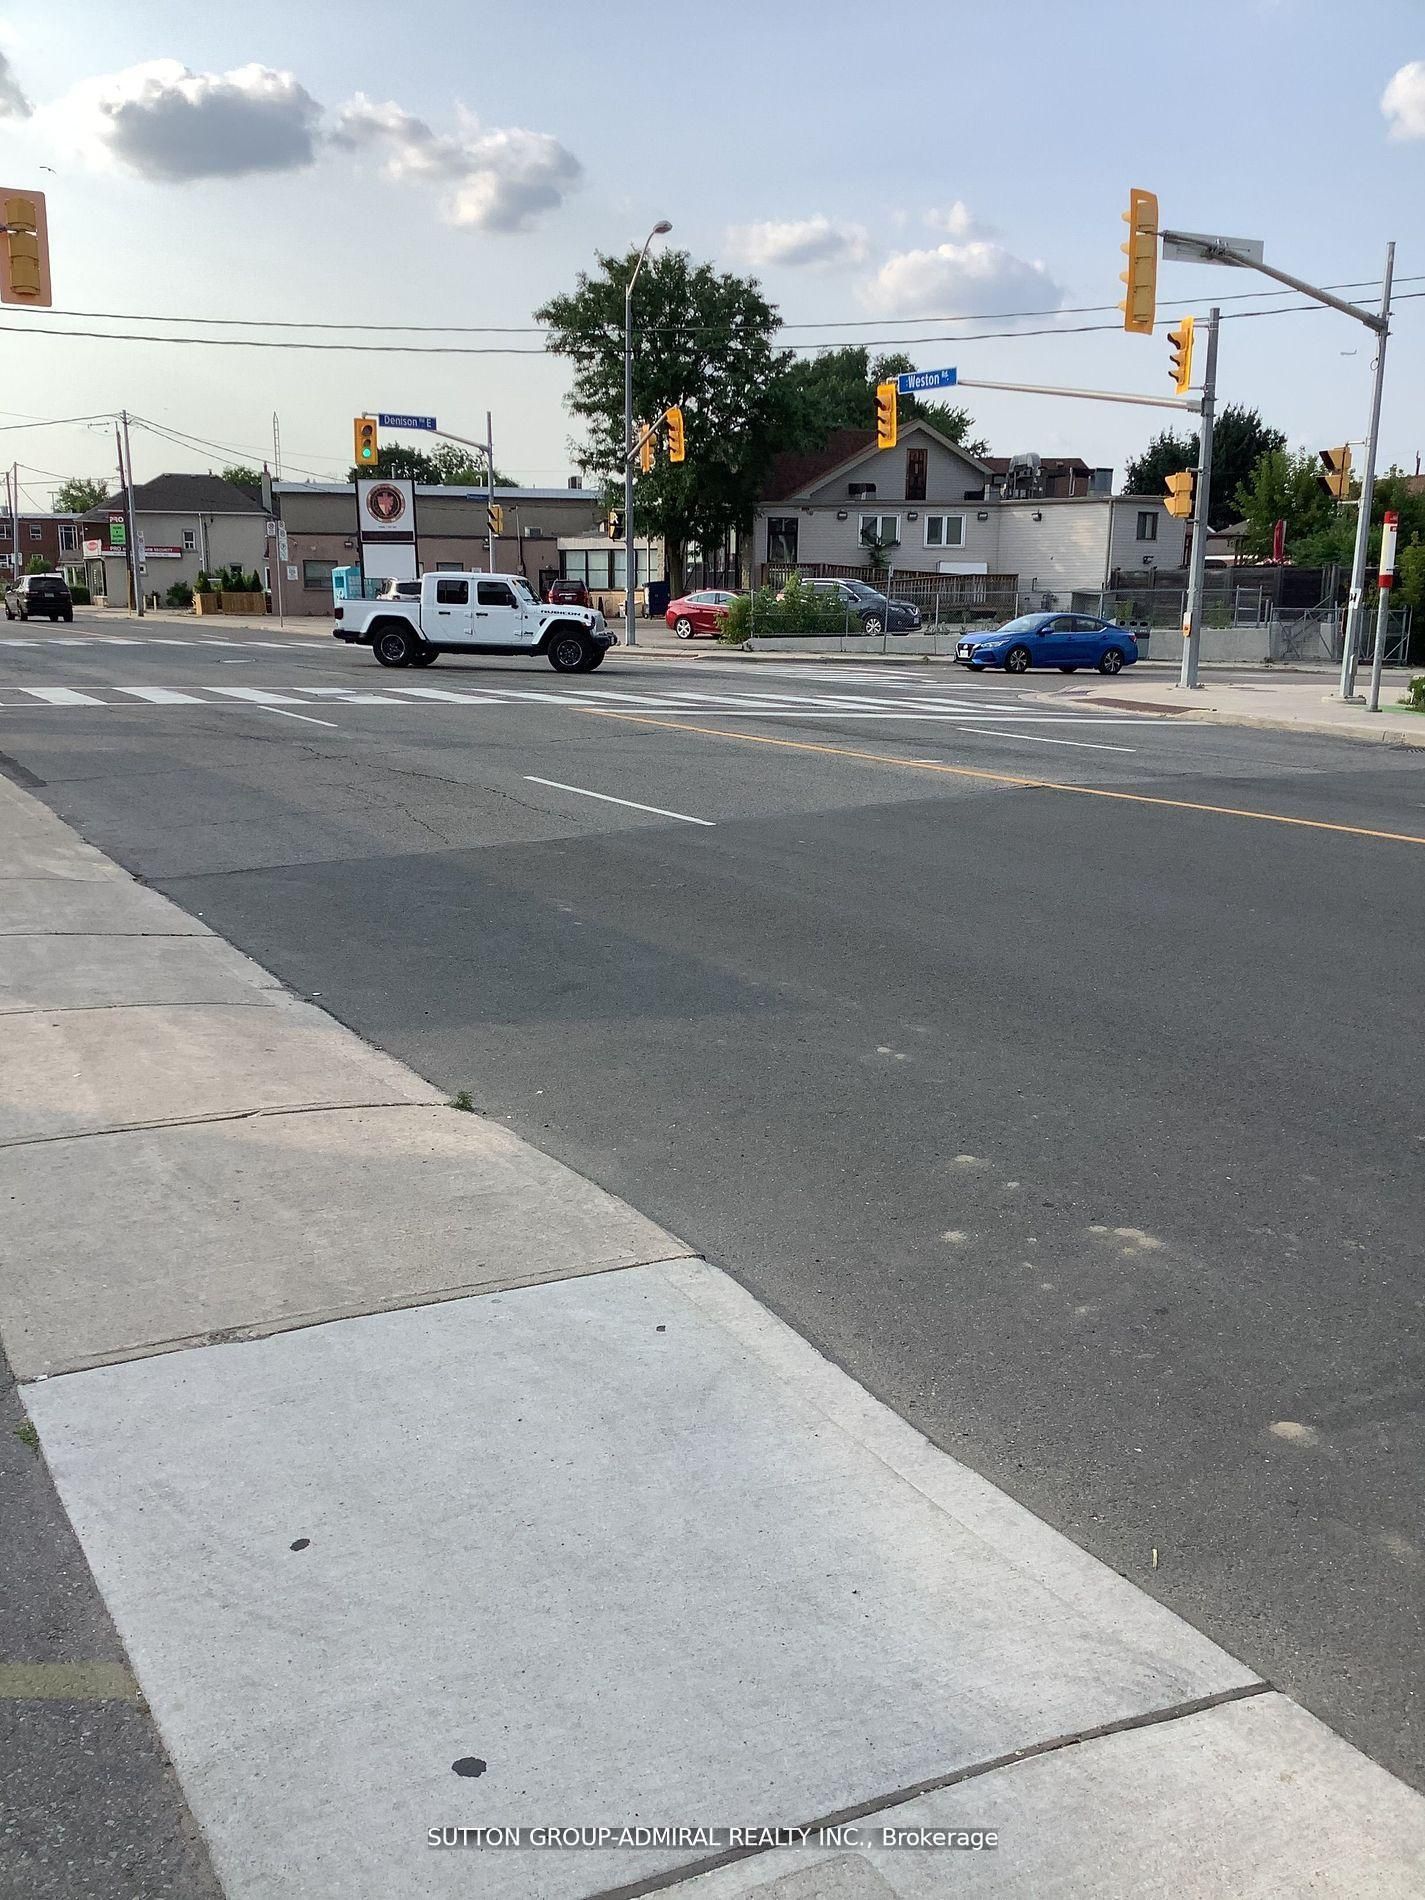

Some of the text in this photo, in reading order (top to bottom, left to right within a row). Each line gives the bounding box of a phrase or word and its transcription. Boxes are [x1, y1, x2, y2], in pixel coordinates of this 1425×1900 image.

[908, 374, 940, 389] Weston
[384, 415, 418, 427] Denison
[426, 418, 432, 428] E
